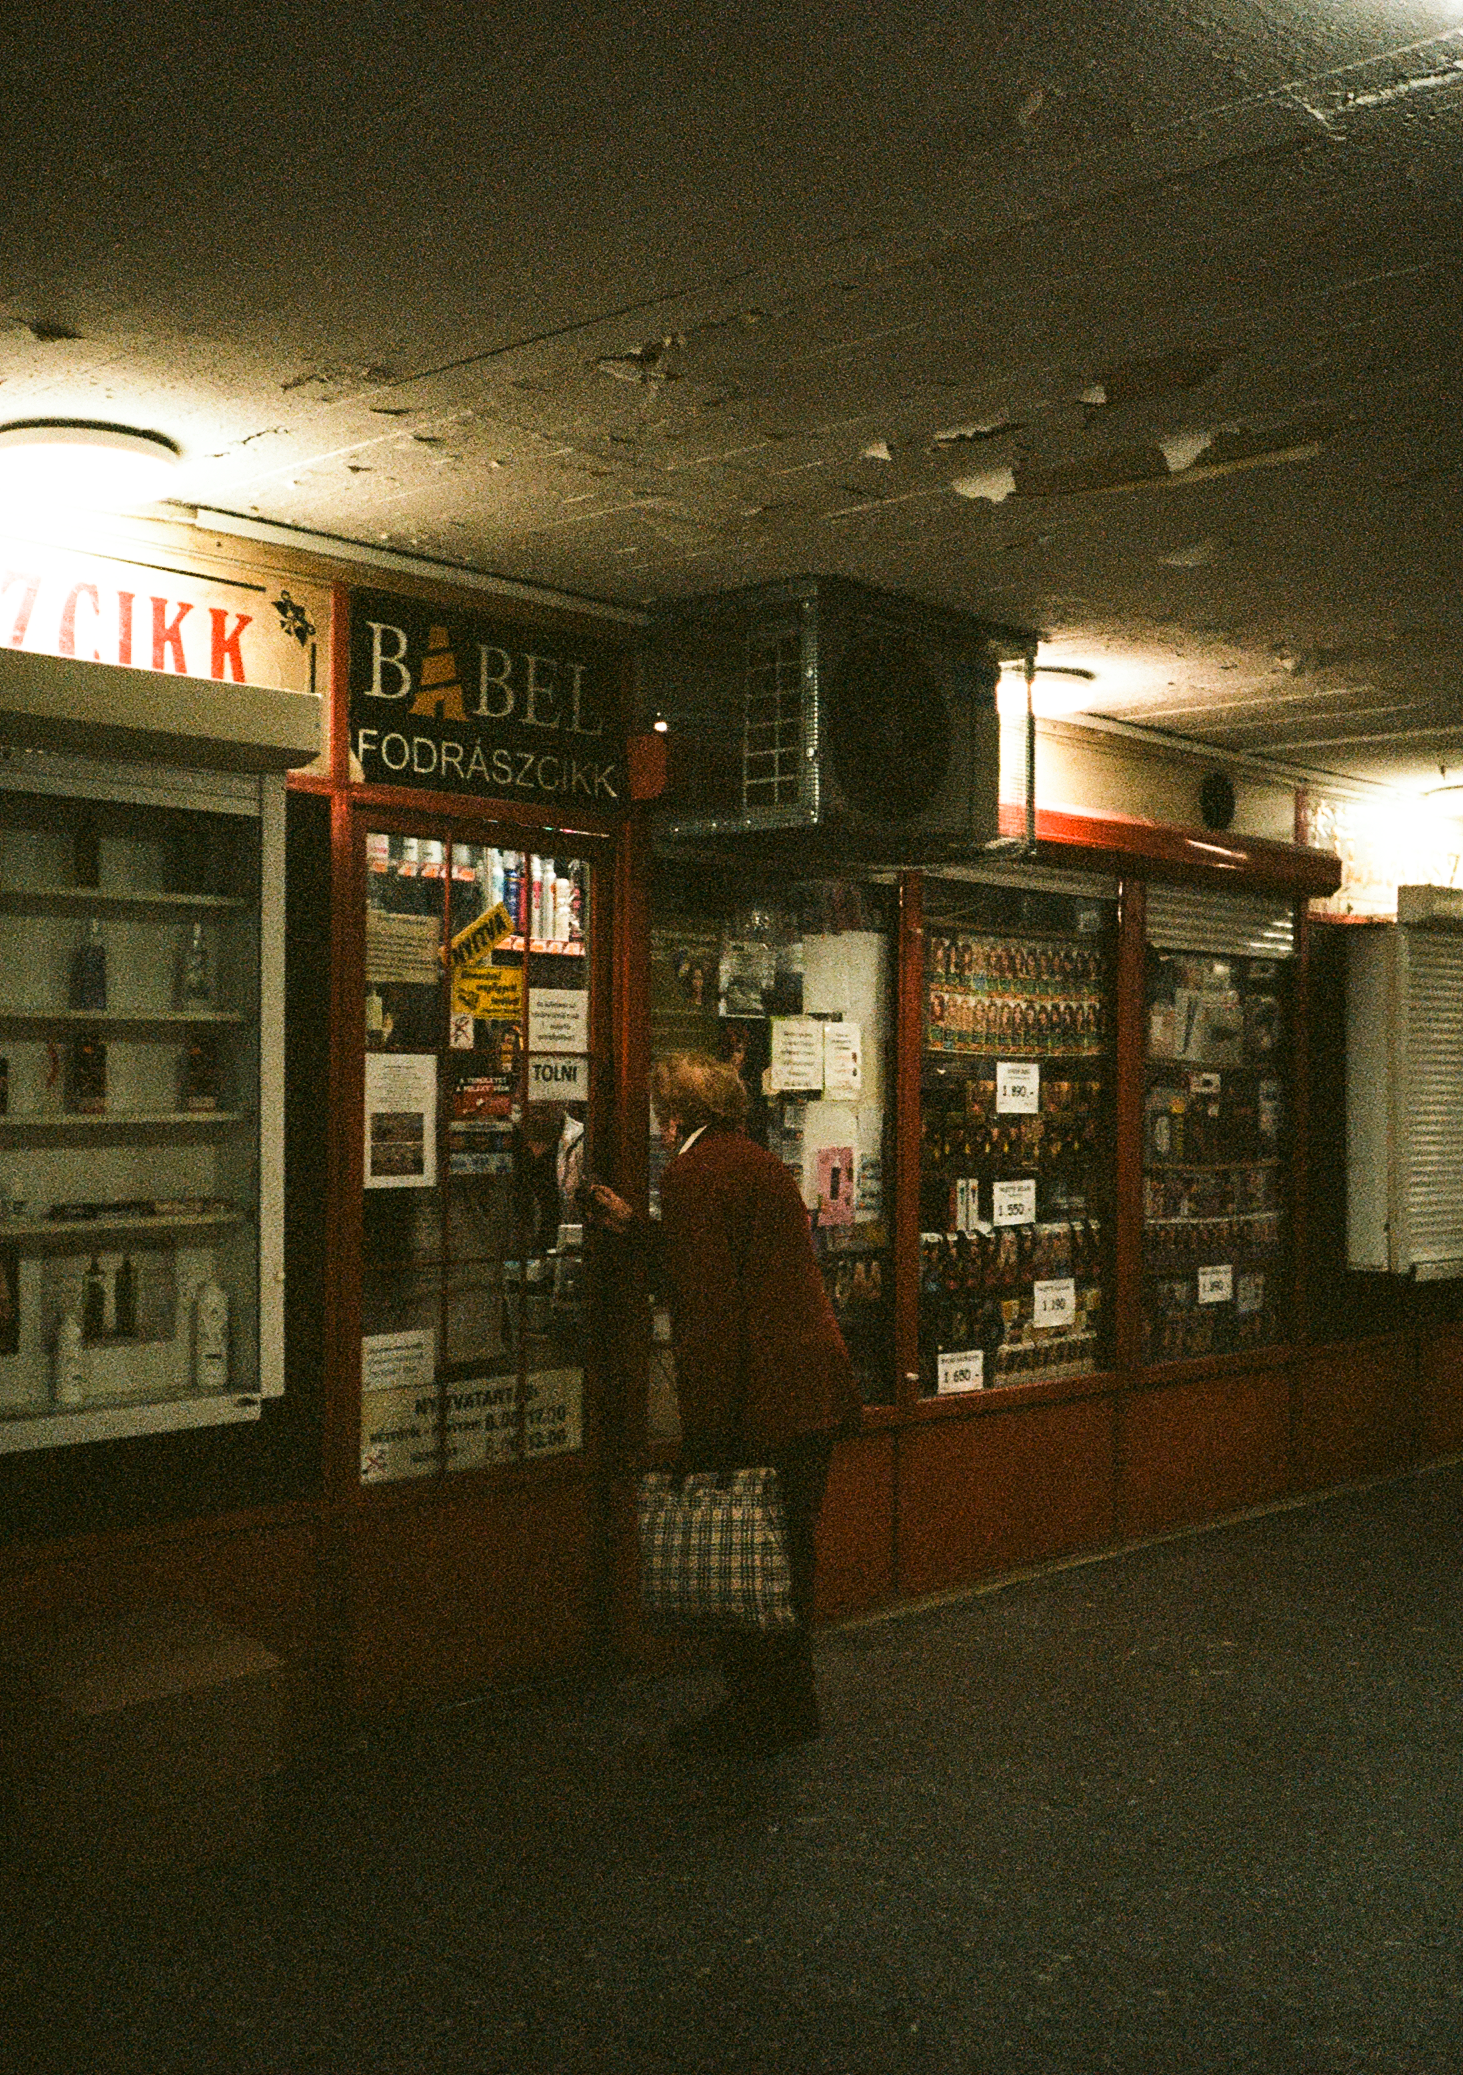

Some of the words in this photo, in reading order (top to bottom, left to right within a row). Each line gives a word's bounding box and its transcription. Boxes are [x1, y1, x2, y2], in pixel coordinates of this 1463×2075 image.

[364, 620, 601, 736] BABEL
[357, 728, 618, 799] FODRÁSZCIKK
[531, 1064, 578, 1083] TOLNI
